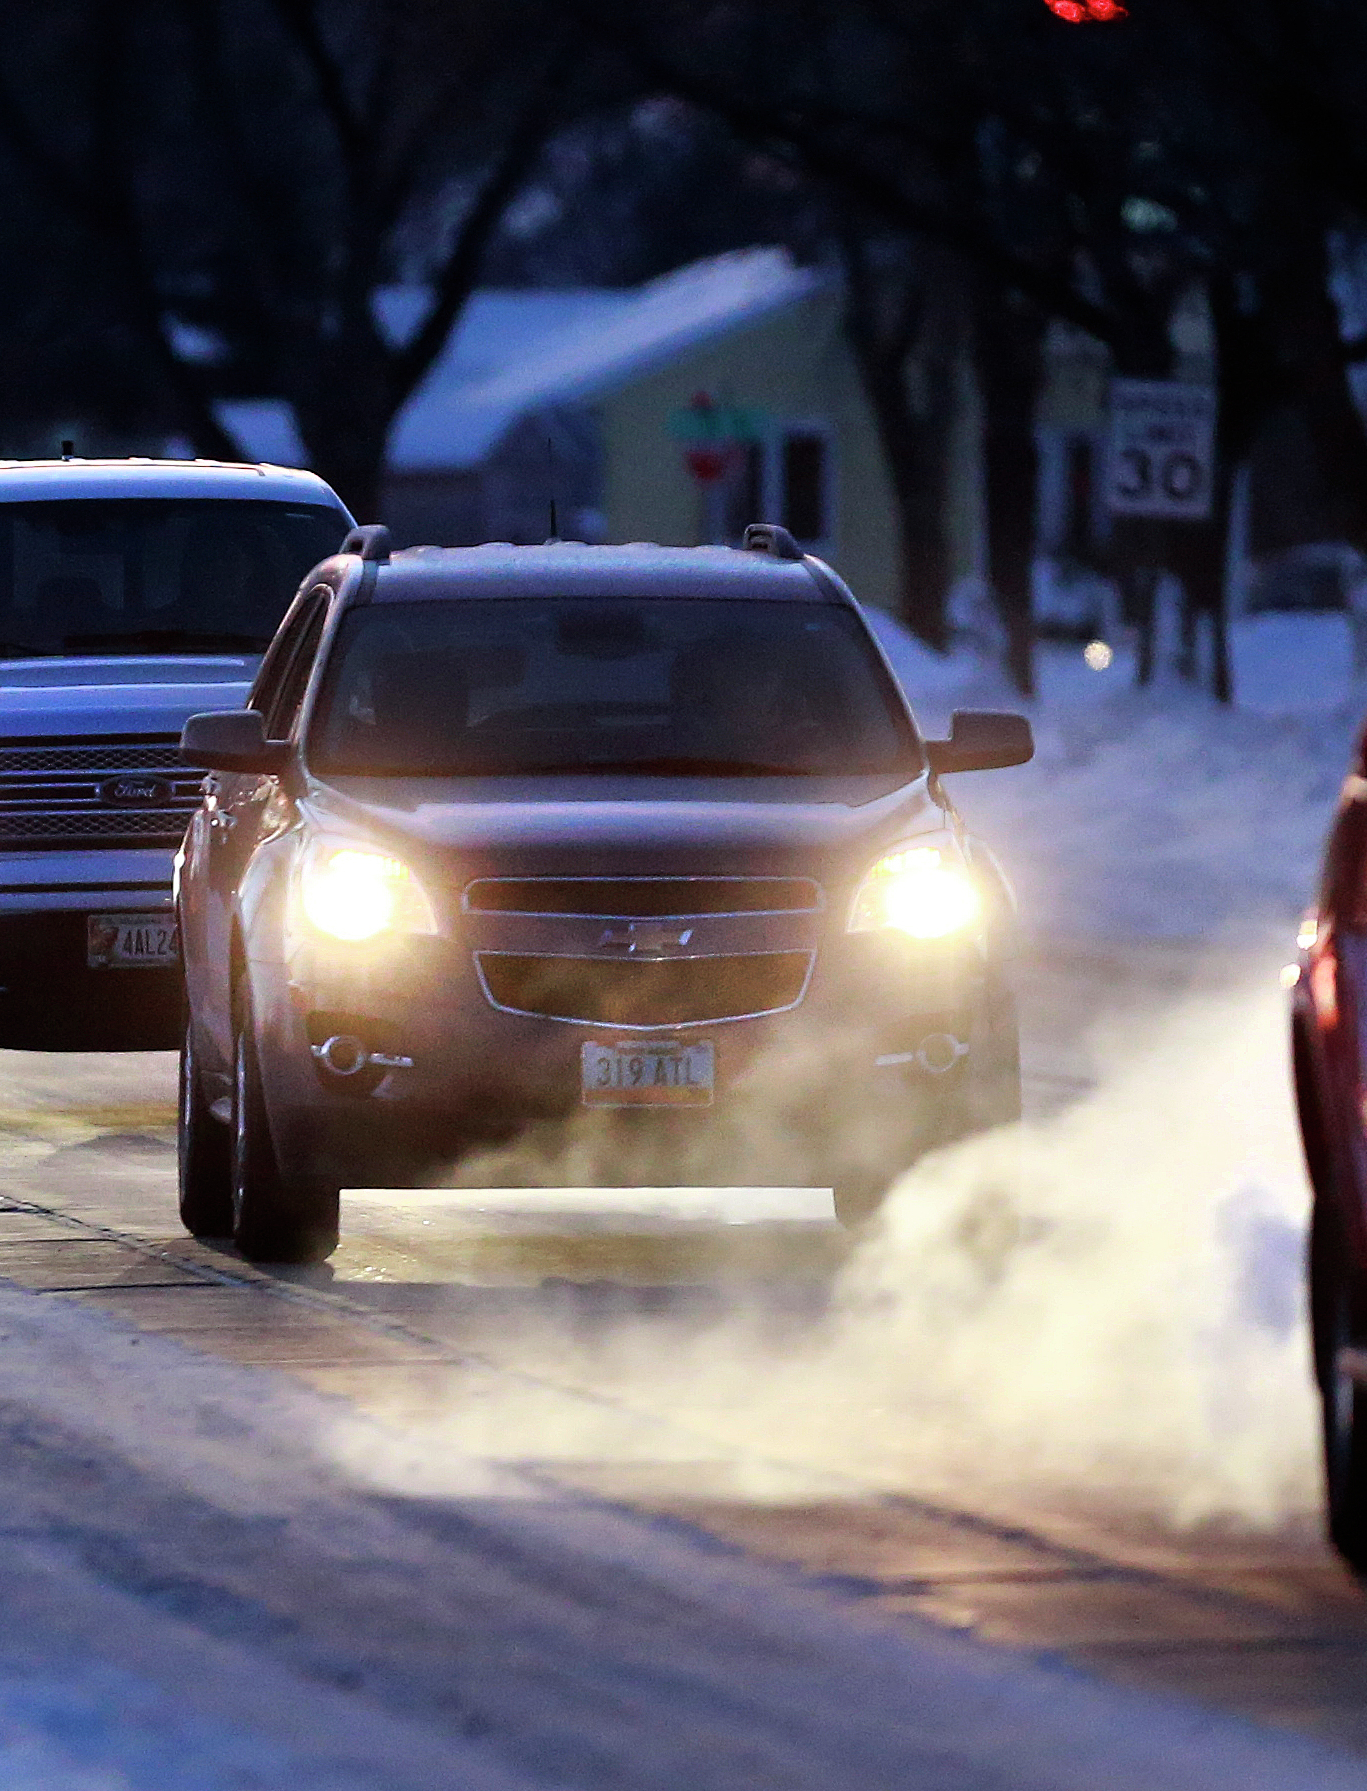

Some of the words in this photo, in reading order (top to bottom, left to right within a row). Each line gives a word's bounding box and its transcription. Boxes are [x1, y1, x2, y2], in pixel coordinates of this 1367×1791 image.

[1118, 447, 1203, 502] 30
[113, 782, 157, 798] Ford
[596, 1057, 644, 1086] 319
[653, 1057, 701, 1086] ATL
